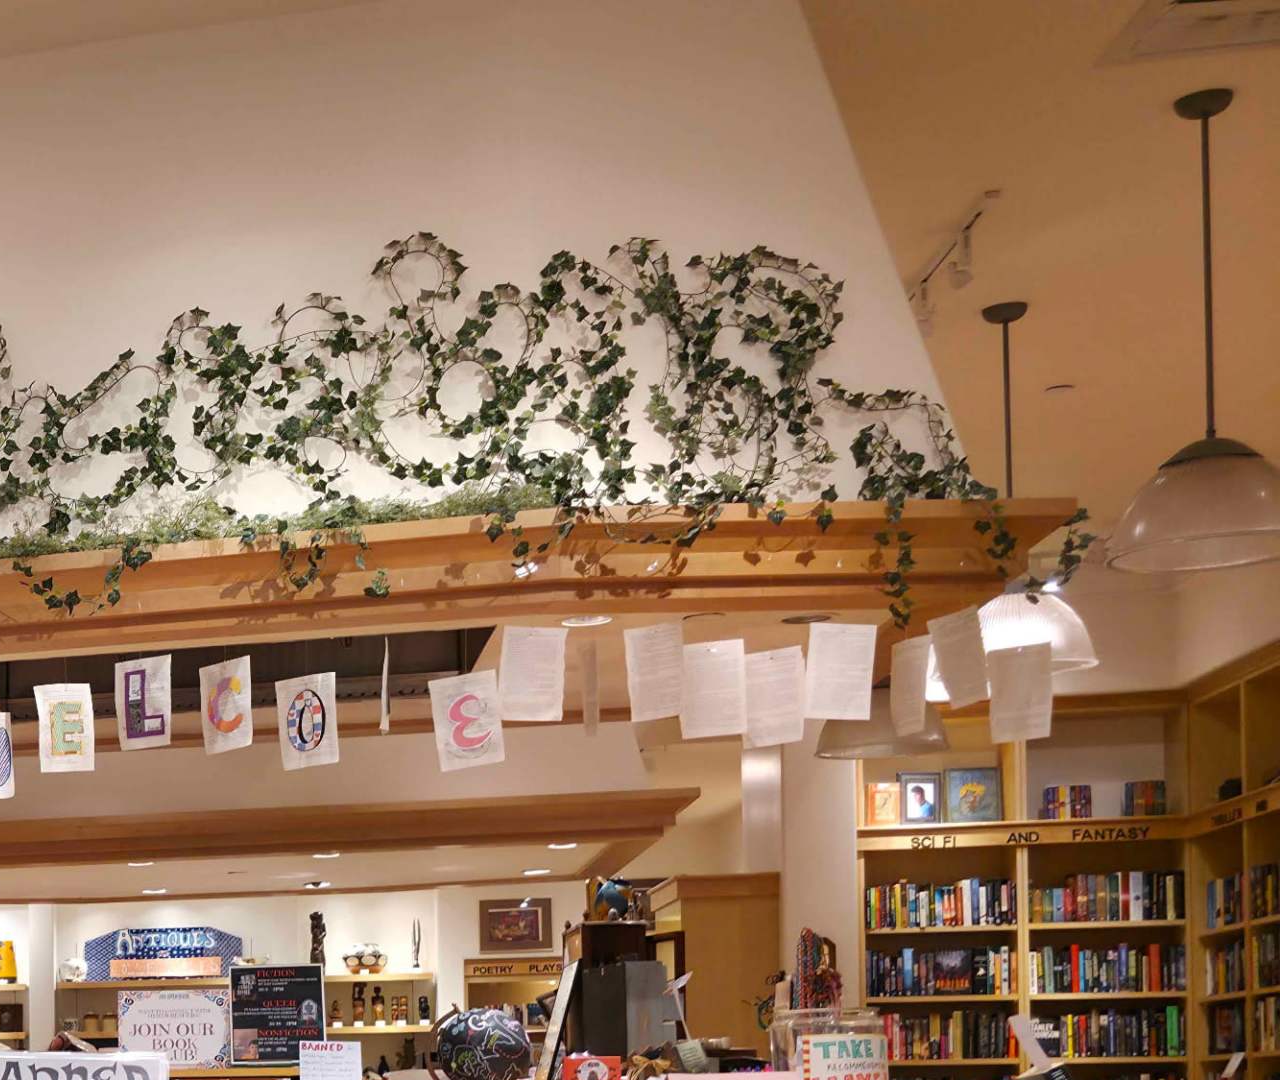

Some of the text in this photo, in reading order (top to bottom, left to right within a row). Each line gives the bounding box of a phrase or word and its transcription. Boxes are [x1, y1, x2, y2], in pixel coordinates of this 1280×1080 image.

[910, 826, 1151, 849] SCI FI AND FANTASY
[129, 1023, 214, 1037] JOIN OUR
[152, 1038, 198, 1049] BOOK
[812, 1039, 873, 1059] TAKE
[169, 1050, 198, 1061] LUB!
